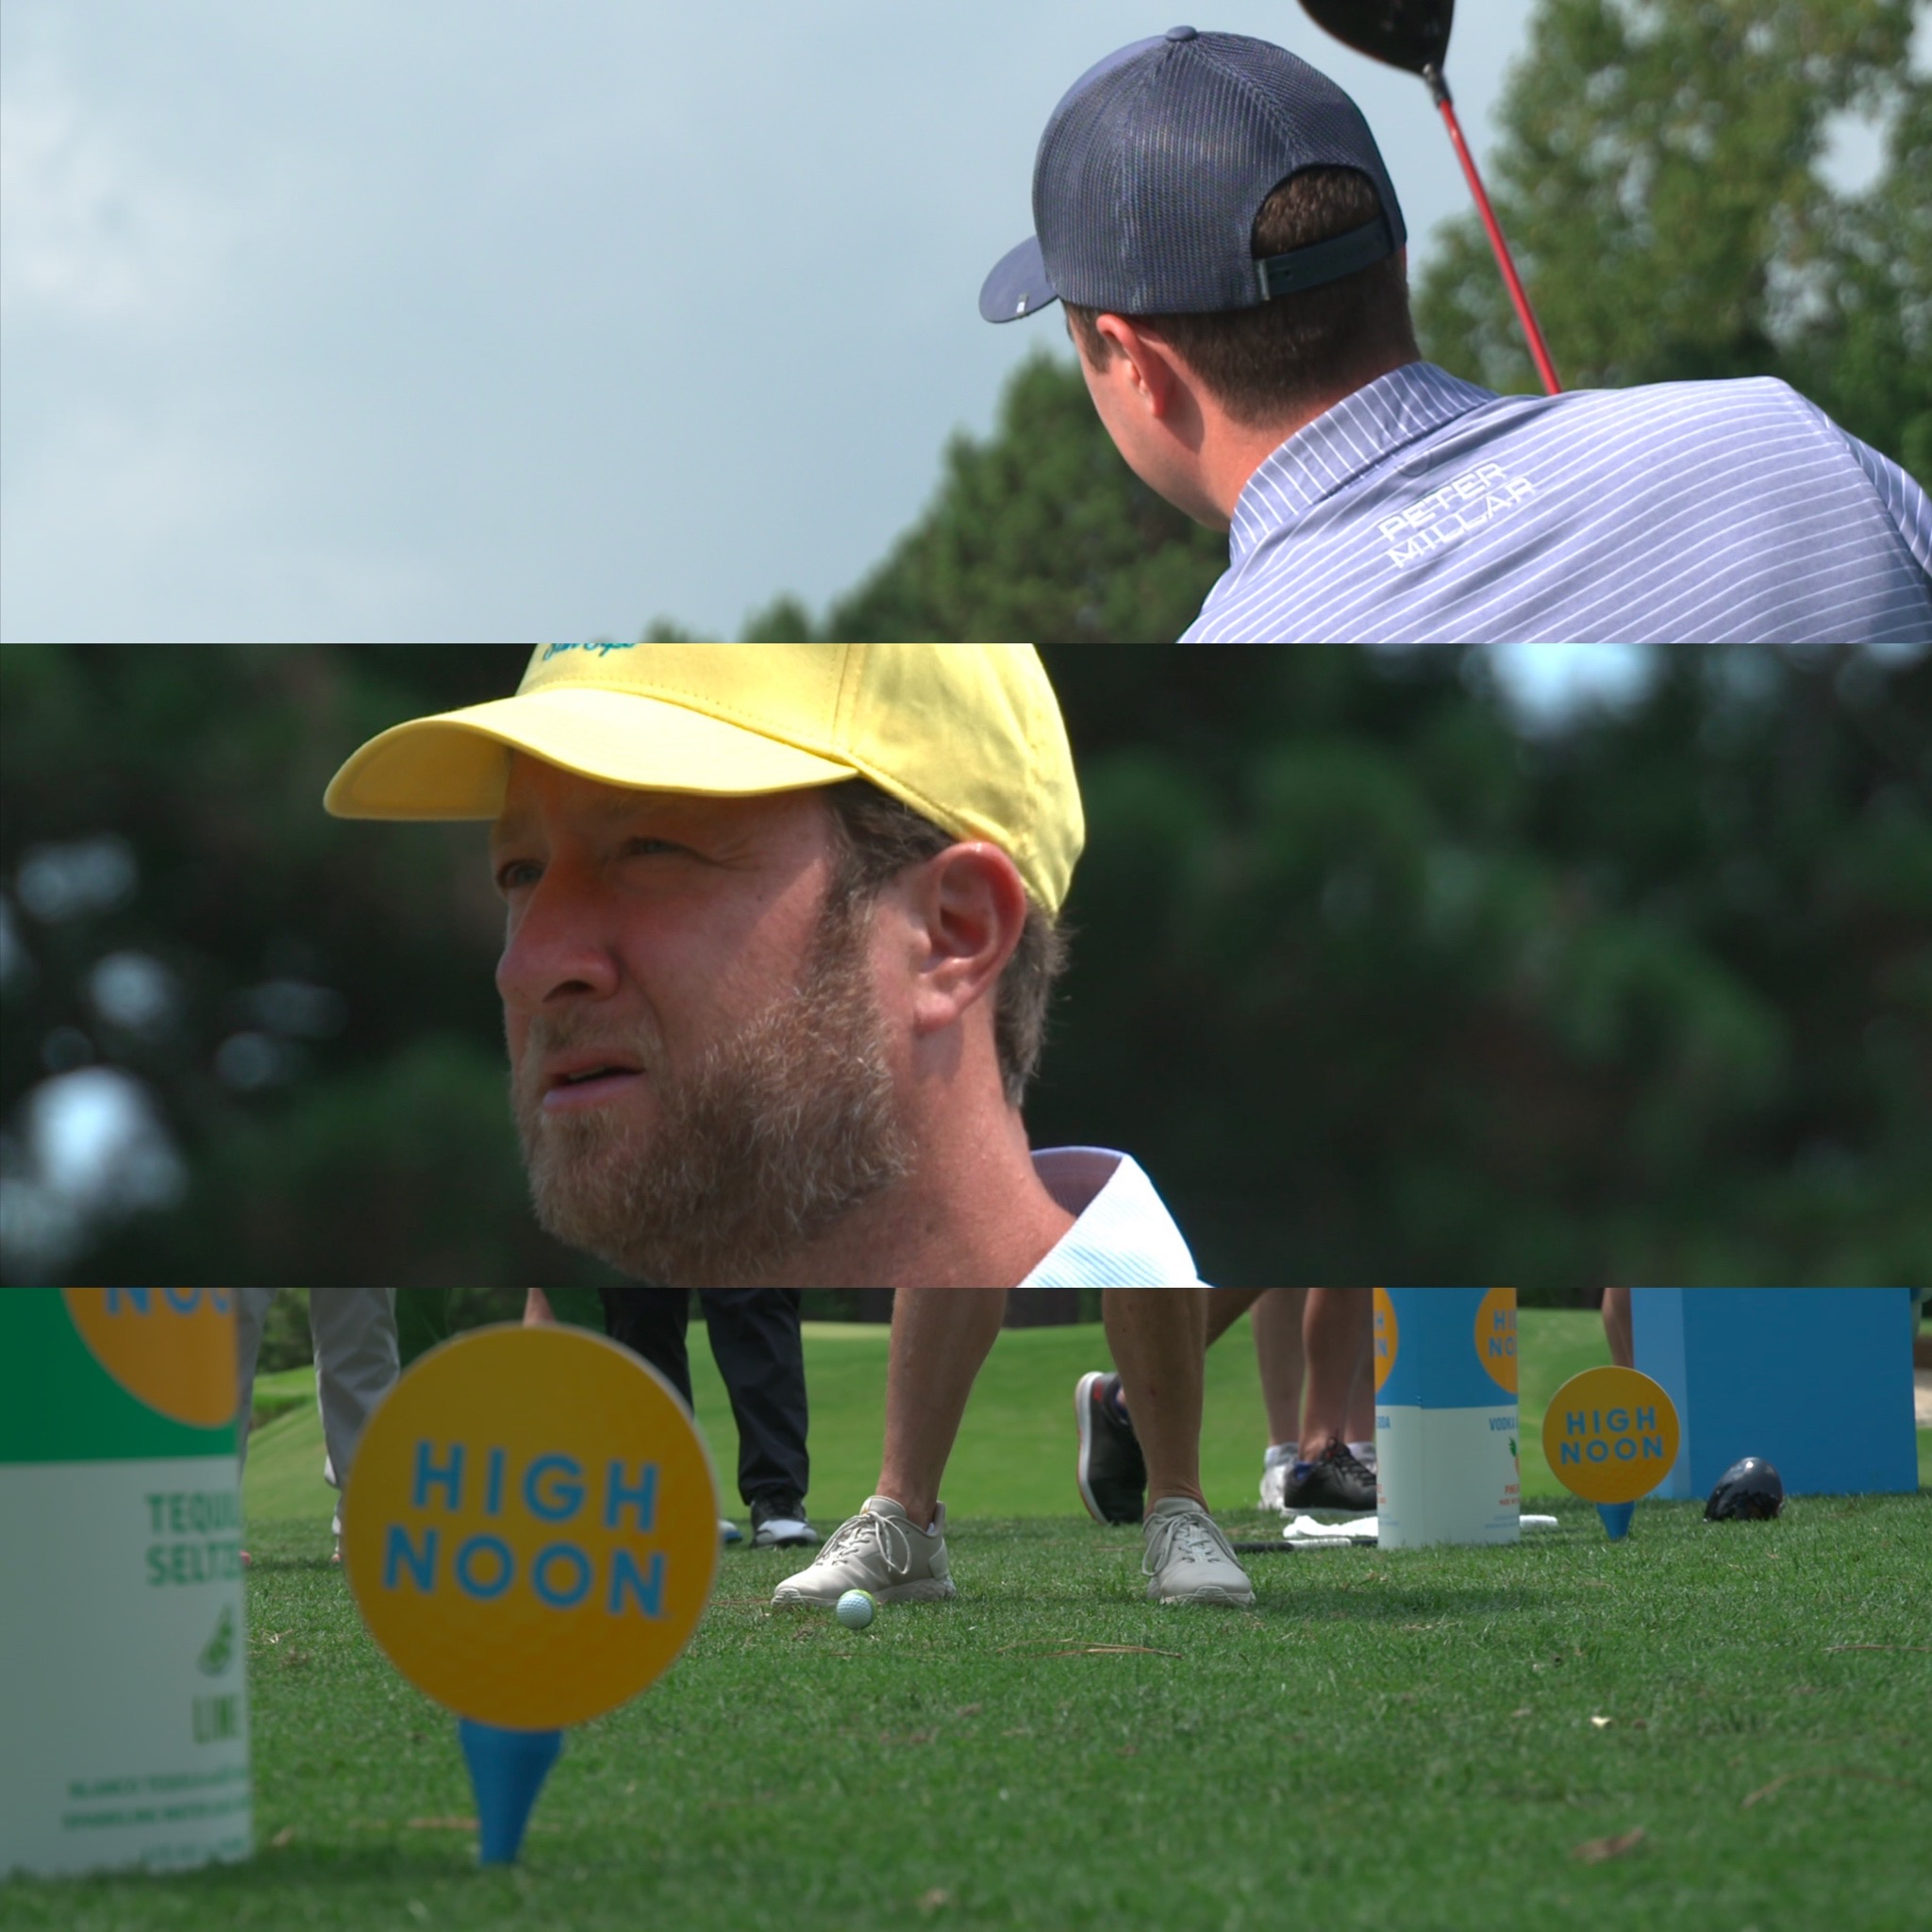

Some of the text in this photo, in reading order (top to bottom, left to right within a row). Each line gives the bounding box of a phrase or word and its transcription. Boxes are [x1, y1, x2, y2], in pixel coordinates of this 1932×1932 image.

[1378, 461, 1507, 542] PETER
[1387, 475, 1536, 569] MILLAR
[1560, 1434, 1664, 1465] NOON
[1566, 1405, 1657, 1435] HIGH
[412, 1440, 659, 1533] HIGH
[382, 1523, 667, 1619] NOON
